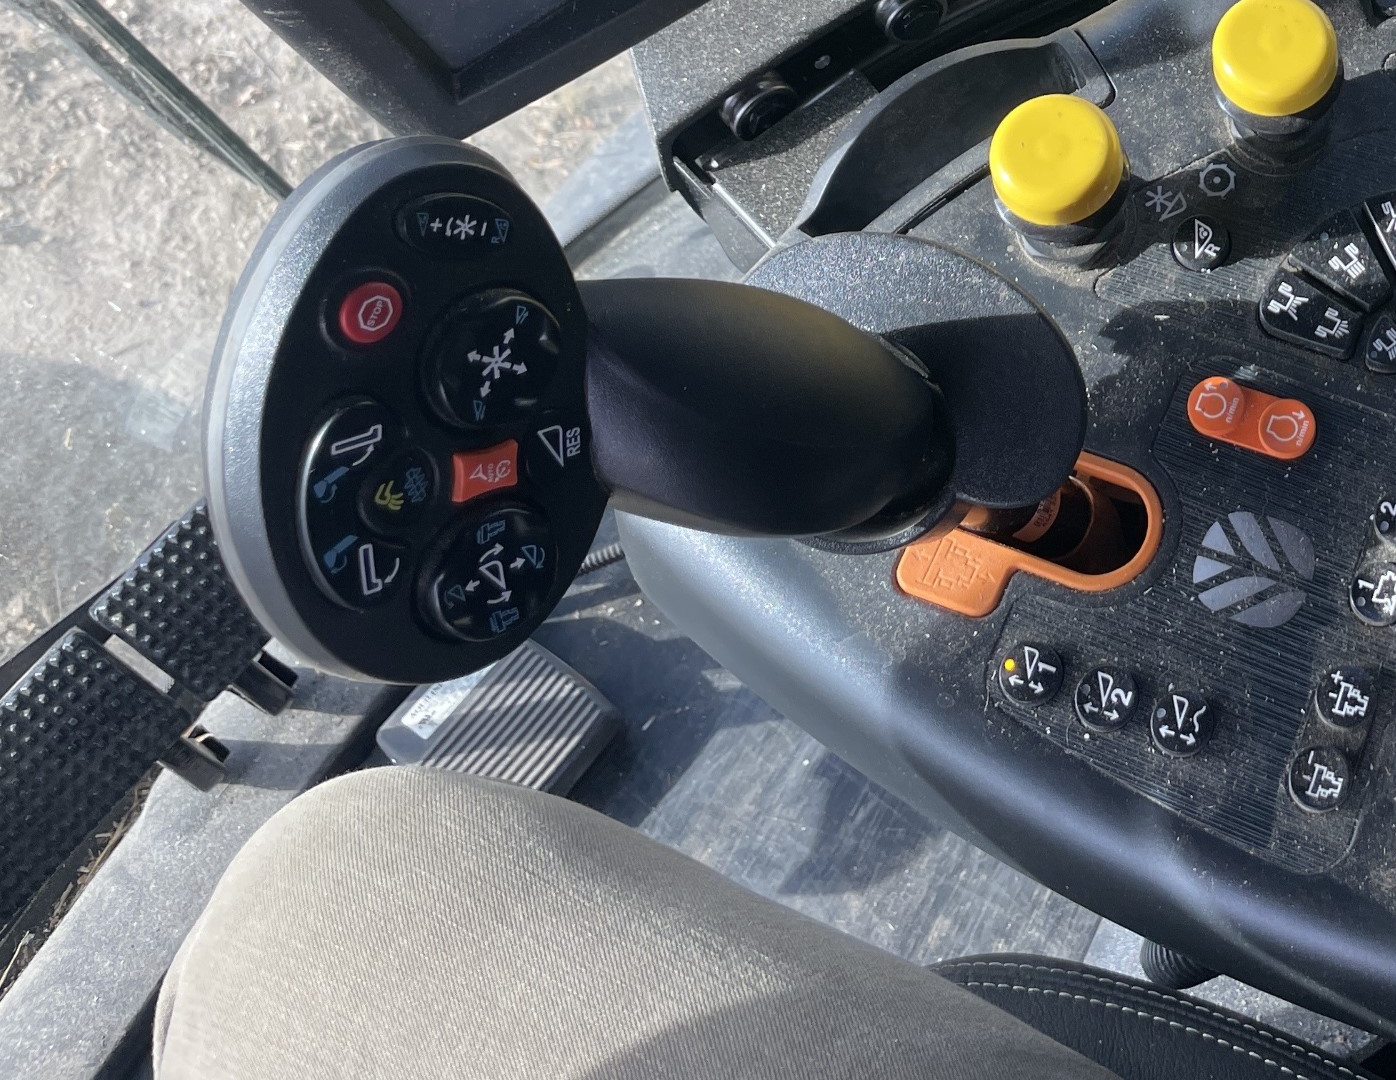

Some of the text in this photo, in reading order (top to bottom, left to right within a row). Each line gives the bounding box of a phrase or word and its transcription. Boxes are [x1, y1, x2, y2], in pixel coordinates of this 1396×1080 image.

[1204, 243, 1221, 257] R
[367, 300, 383, 326] STOP
[1225, 397, 1239, 424] n/min
[566, 427, 580, 458] RES
[1296, 420, 1310, 446] n/min
[1358, 579, 1375, 590] 1
[1038, 661, 1057, 674] 1
[1110, 688, 1133, 707] 2
